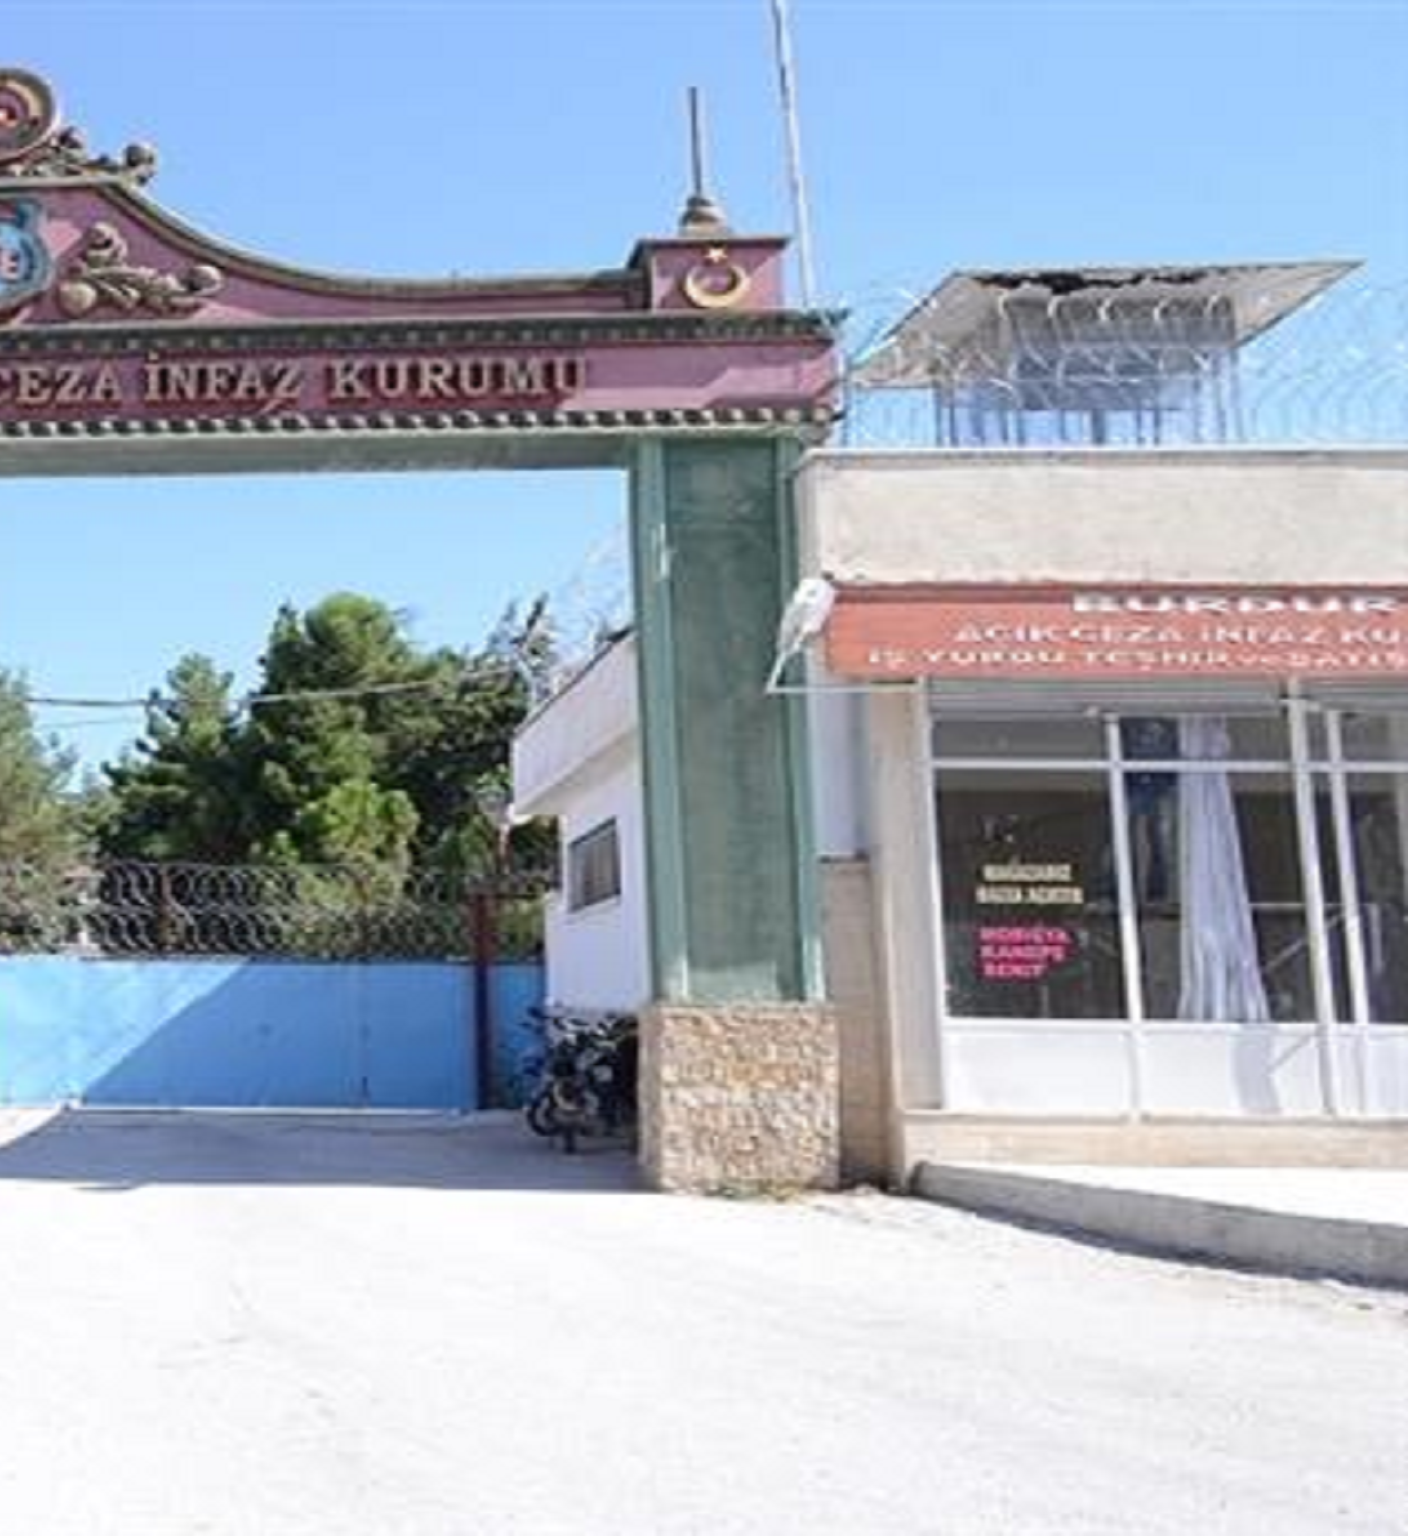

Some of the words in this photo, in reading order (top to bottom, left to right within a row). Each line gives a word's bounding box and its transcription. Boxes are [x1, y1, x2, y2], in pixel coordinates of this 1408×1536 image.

[144, 351, 303, 403] İNFAZ
[329, 355, 588, 400] KURUMU
[1072, 593, 1398, 613] BURDUR
[1068, 624, 1184, 643] CEZA
